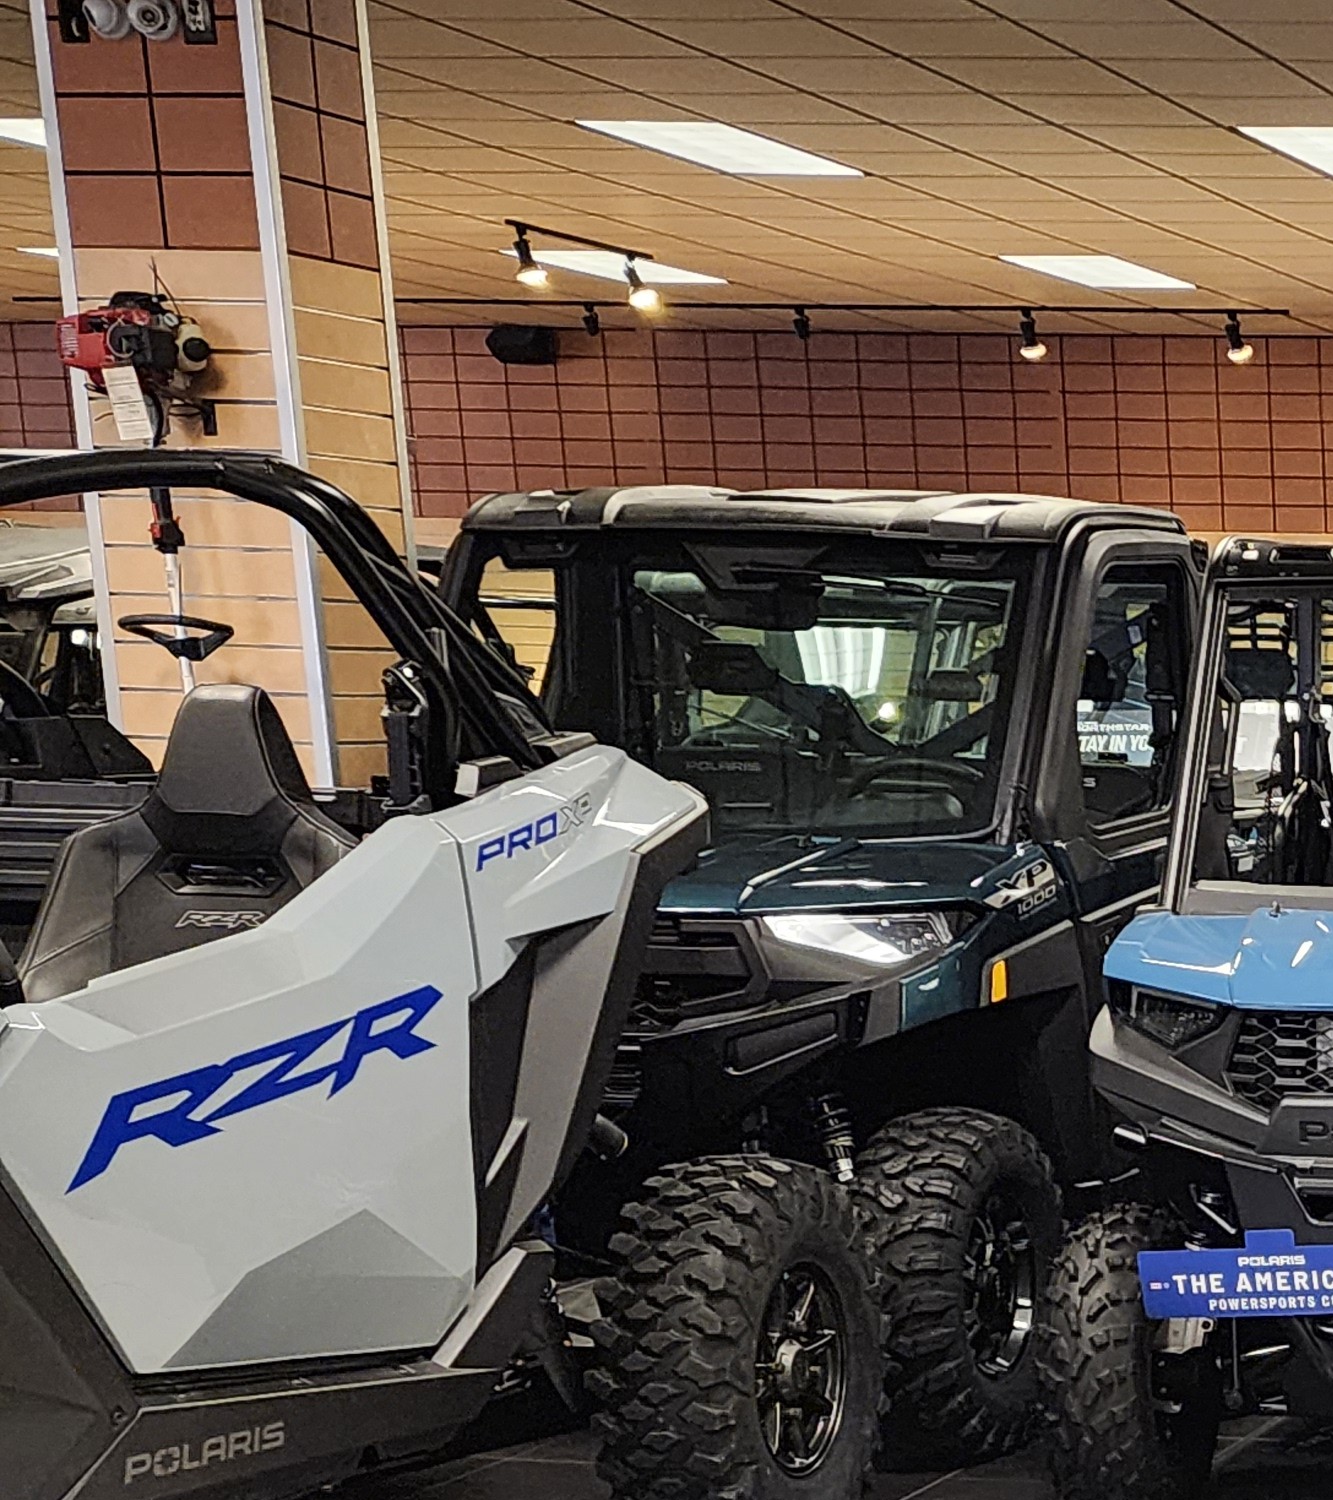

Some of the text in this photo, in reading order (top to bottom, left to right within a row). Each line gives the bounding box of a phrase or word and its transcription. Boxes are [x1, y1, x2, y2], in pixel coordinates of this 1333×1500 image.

[1078, 722, 1151, 733] ORTHSTAR
[1079, 735, 1152, 753] TAY IN YO
[1018, 884, 1056, 914] 1000
[174, 910, 265, 929] RZR
[65, 984, 444, 1195] RZR
[1237, 1254, 1306, 1268] POLARIS
[1172, 1273, 1226, 1294] THE
[1208, 1296, 1316, 1311] POWERSPORTS
[125, 1421, 286, 1485] POLARIS
